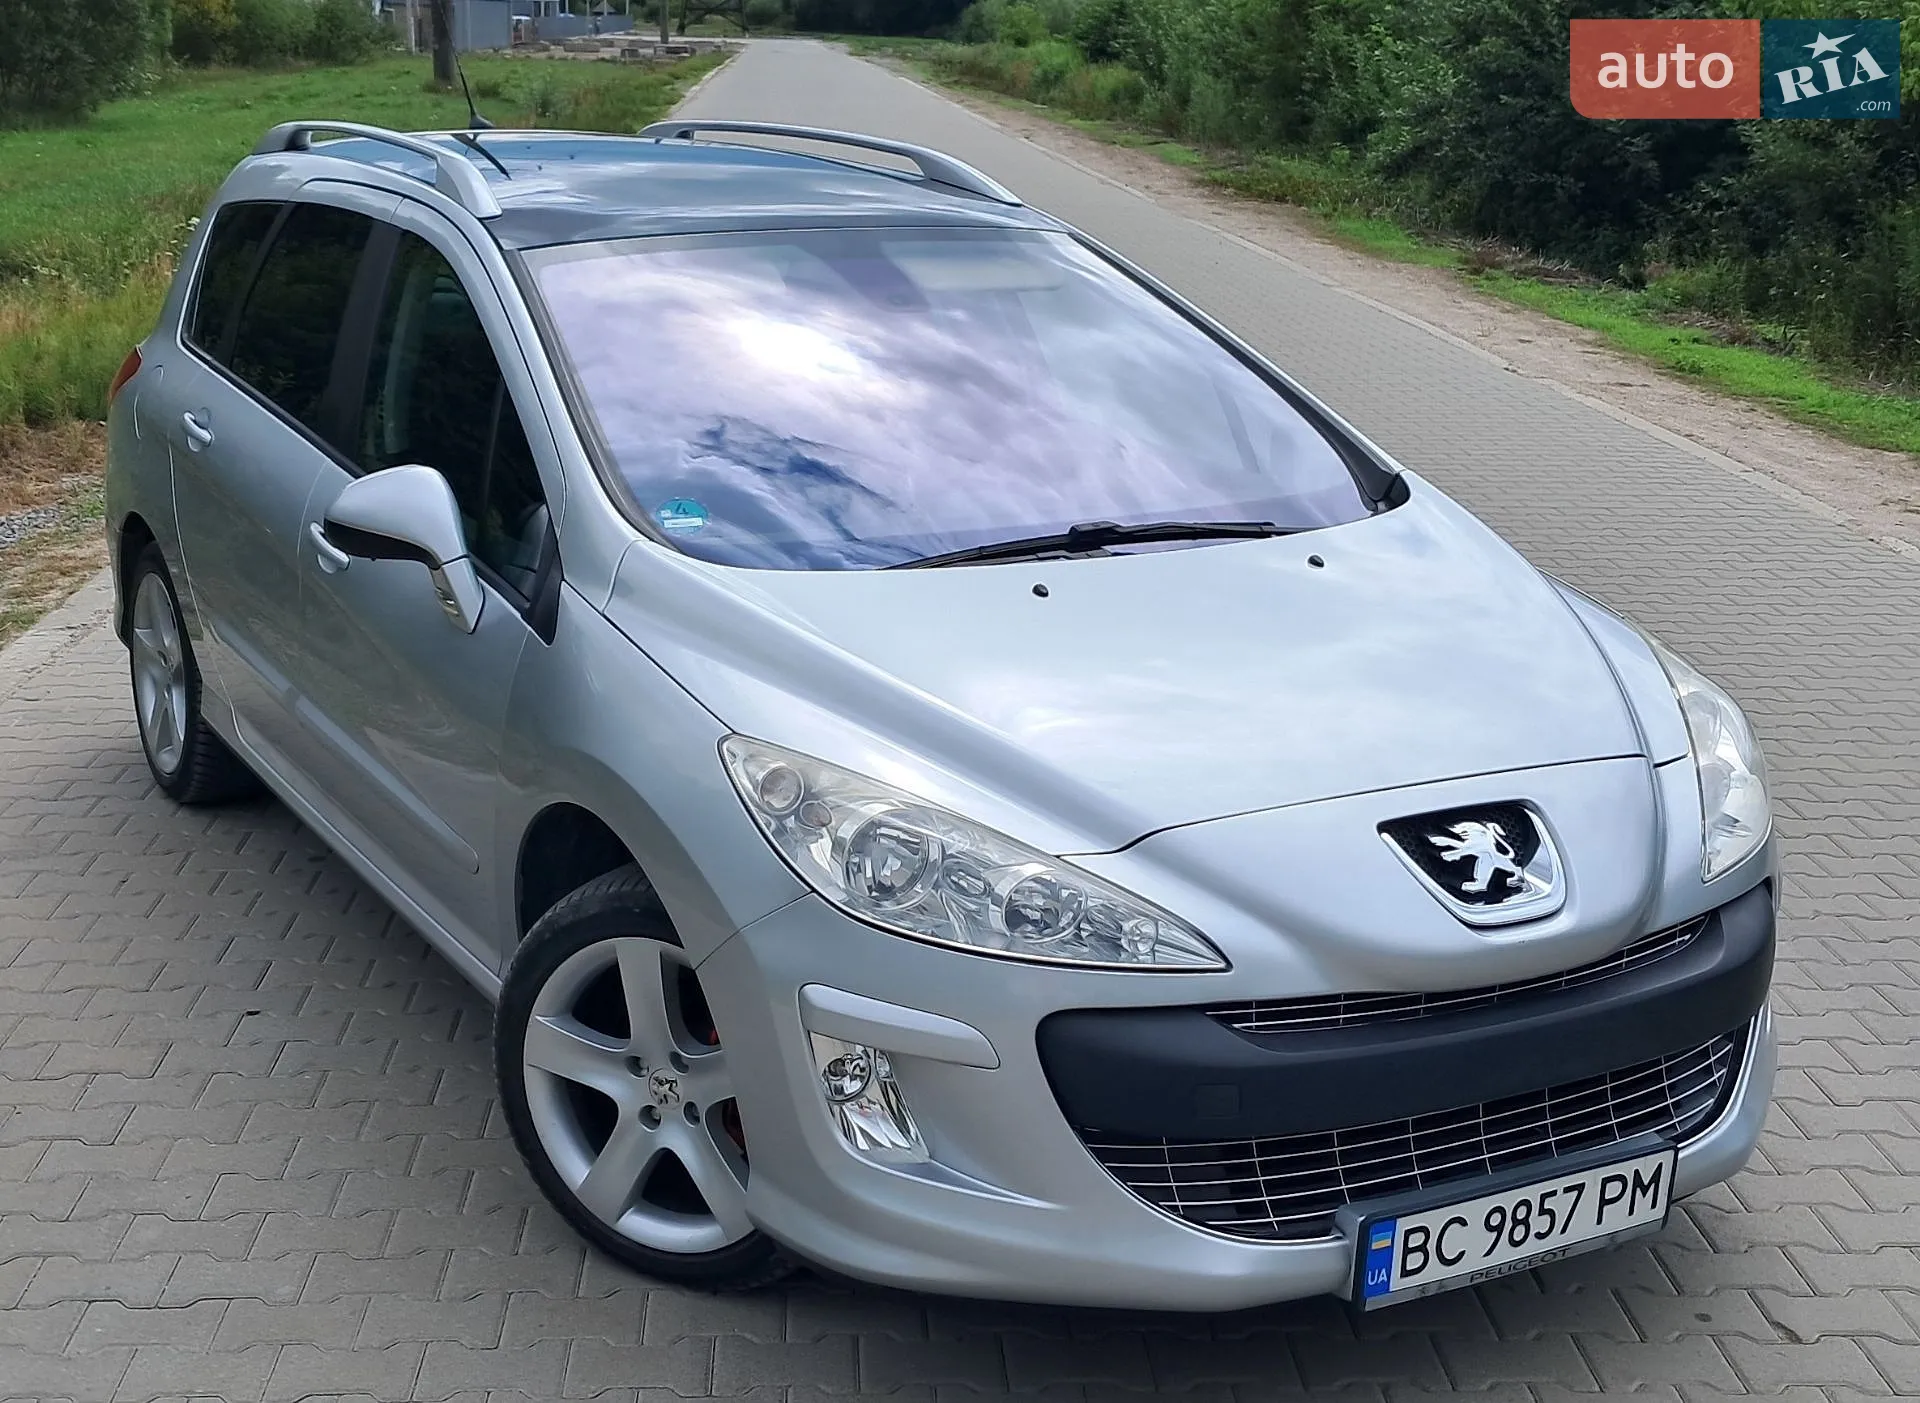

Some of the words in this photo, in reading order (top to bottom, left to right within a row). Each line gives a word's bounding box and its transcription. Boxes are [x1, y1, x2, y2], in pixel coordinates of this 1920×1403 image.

[1399, 1215, 1469, 1279] BC
[1482, 1182, 1586, 1258] 9857
[1596, 1161, 1664, 1226] PM
[1367, 1267, 1388, 1286] UA
[1469, 1248, 1570, 1284] PEUGEOT
